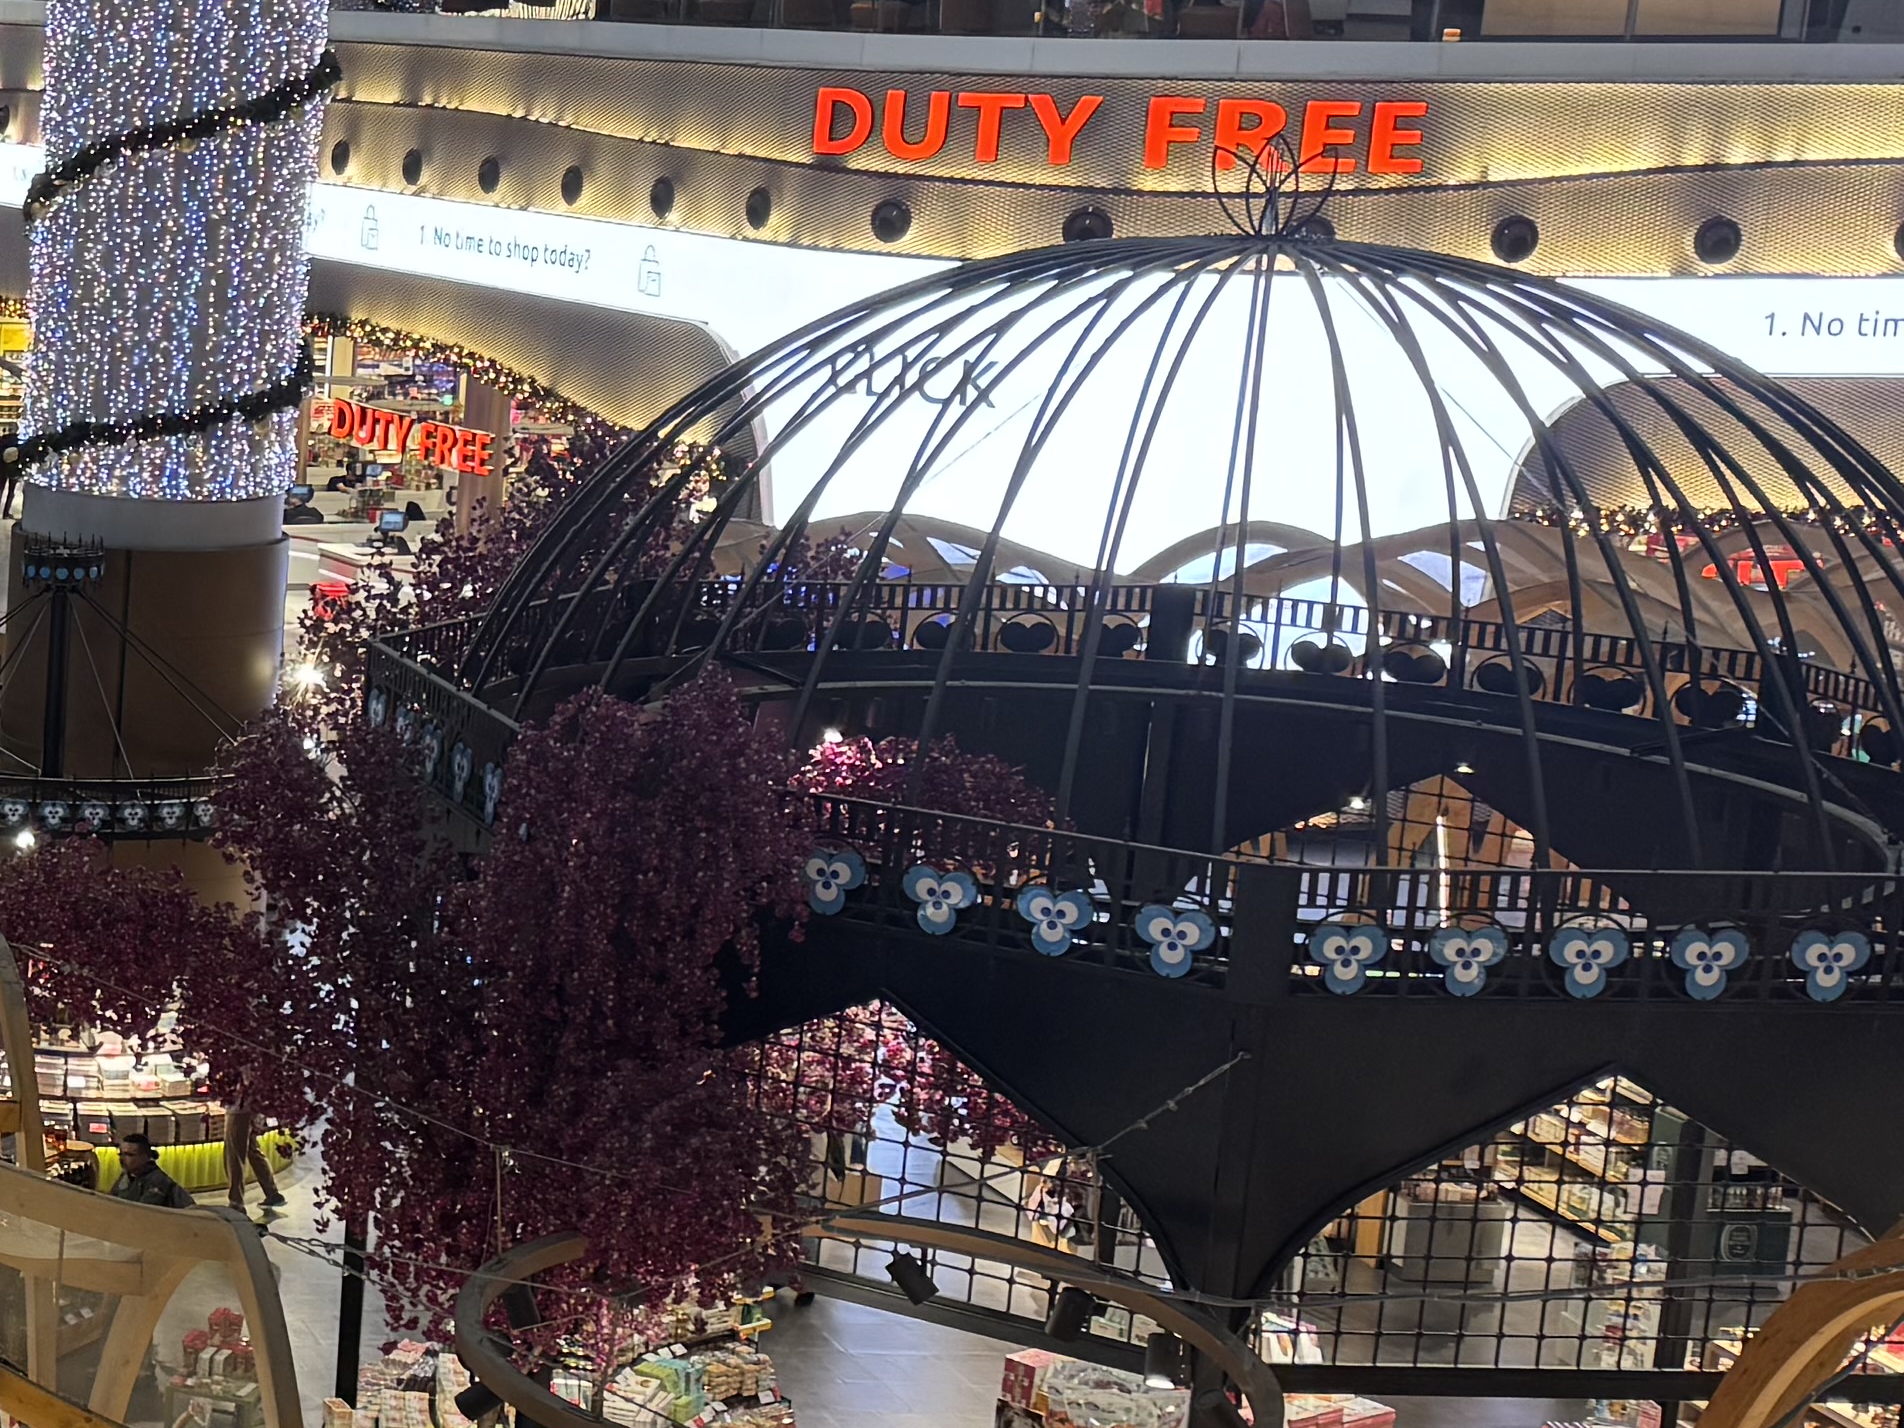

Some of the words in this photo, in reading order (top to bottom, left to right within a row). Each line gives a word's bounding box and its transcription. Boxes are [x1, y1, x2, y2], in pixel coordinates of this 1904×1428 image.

[812, 86, 1104, 165] DUTY
[1144, 95, 1428, 174] FREE
[434, 226, 452, 248] No
[488, 236, 502, 257] to
[506, 236, 539, 267] shop
[544, 242, 592, 274] today?
[1764, 311, 1787, 337] 1.
[1801, 311, 1844, 337] No
[330, 397, 414, 455] DUTY
[419, 421, 494, 476] FREE
